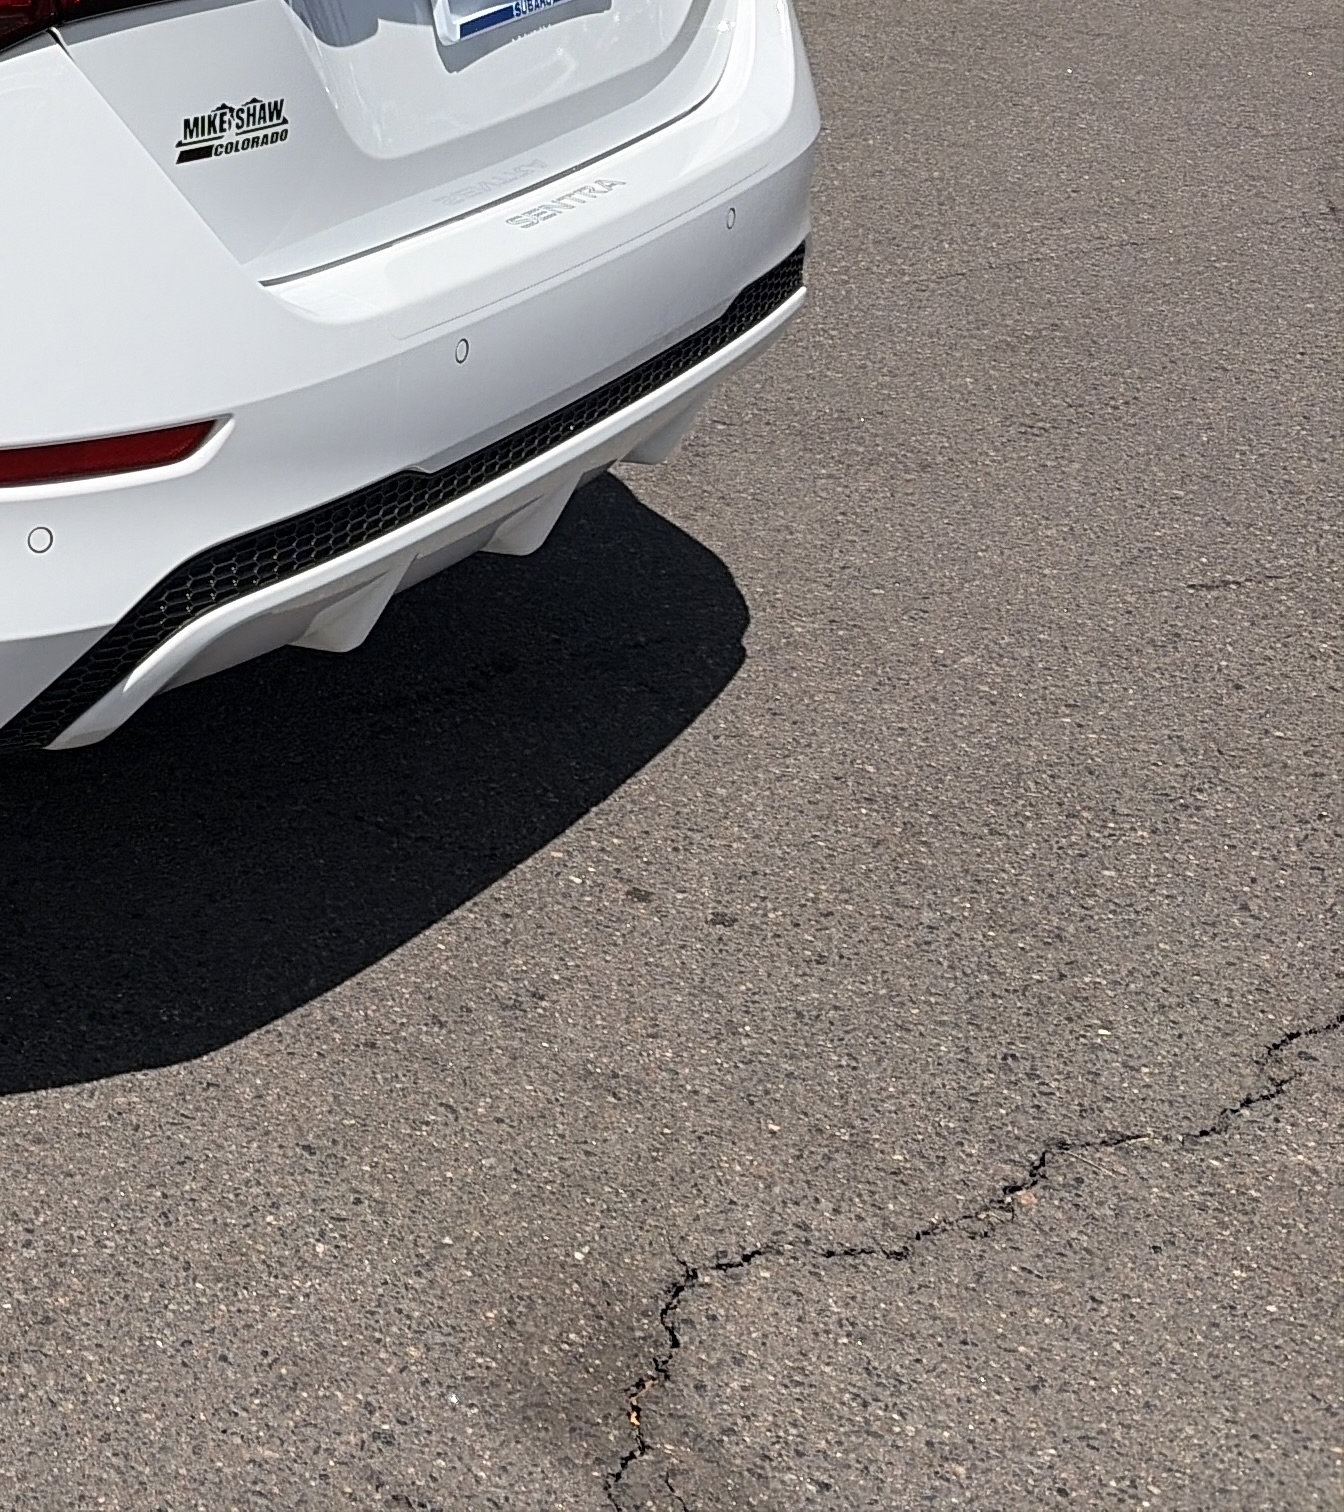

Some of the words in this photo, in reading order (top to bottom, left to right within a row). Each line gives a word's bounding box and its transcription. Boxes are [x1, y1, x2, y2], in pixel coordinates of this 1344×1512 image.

[183, 111, 228, 141] MIKE
[235, 98, 285, 130] SHAW
[214, 128, 289, 157] COLORADO
[504, 179, 627, 229] SENTRA
